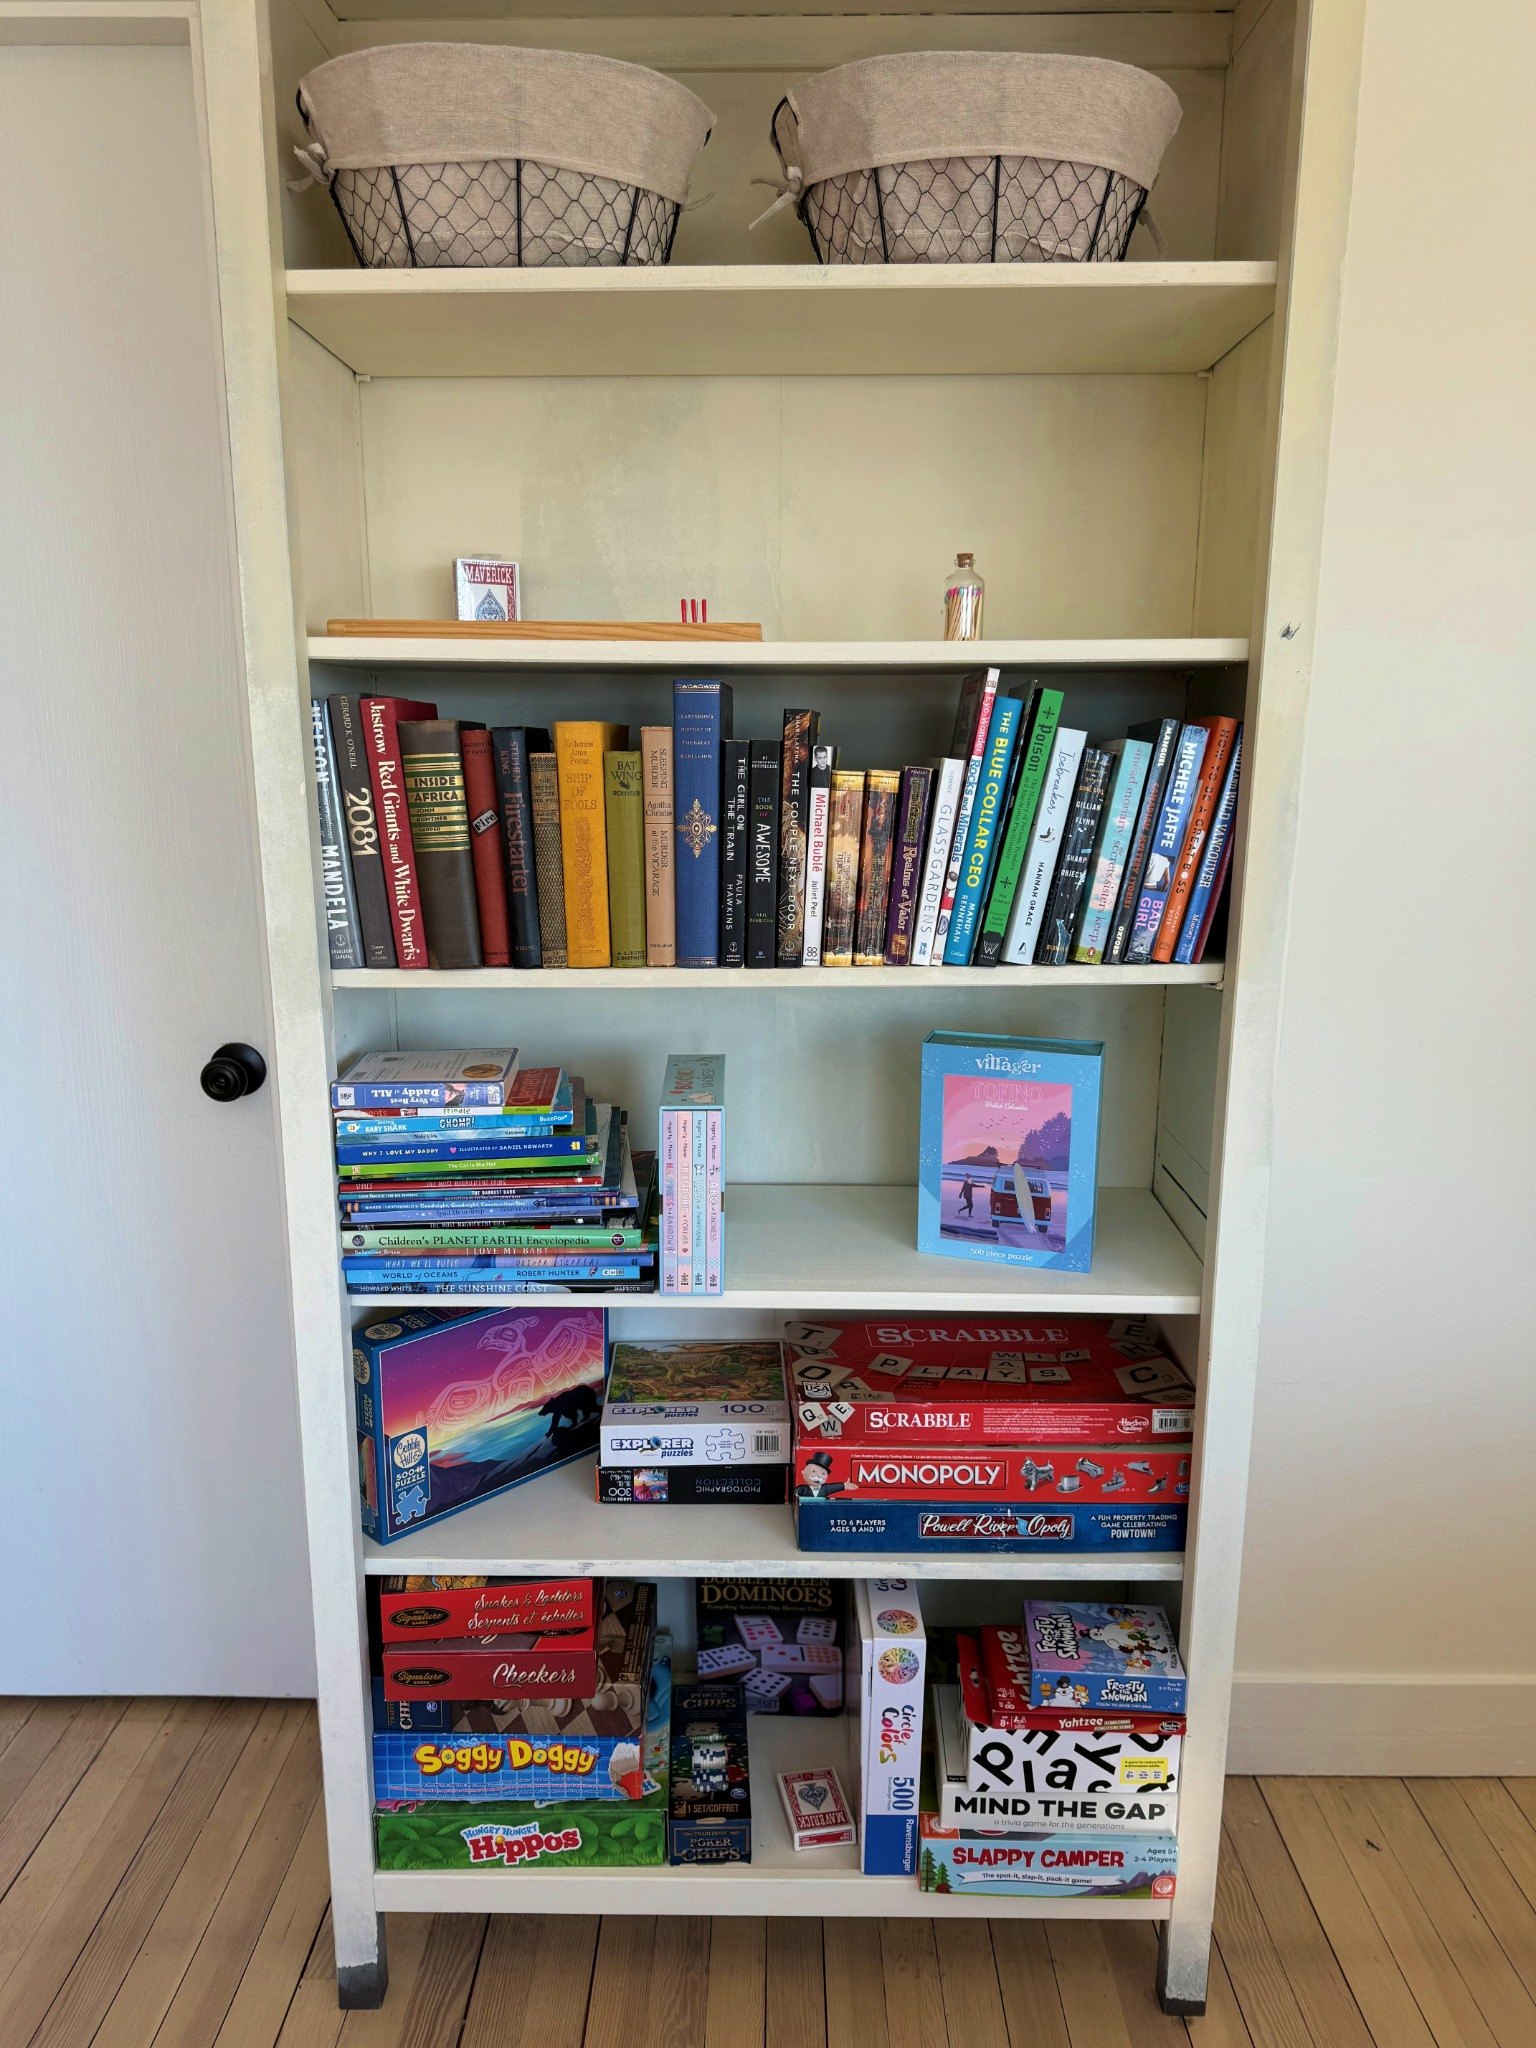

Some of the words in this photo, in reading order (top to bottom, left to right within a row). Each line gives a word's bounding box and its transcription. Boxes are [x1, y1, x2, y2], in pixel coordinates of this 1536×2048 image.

[464, 565, 513, 584] MAVERICK
[370, 702, 387, 755] Jastrow
[1000, 711, 1012, 733] THE
[564, 740, 594, 748] Katherine
[1028, 723, 1053, 772] Poison
[1216, 729, 1229, 760] HOW
[500, 750, 510, 775] KING
[511, 741, 521, 782] STEPHEN
[617, 761, 638, 770] BAT
[651, 750, 659, 788] MURDER
[737, 758, 745, 779] THE
[989, 738, 1009, 779] BLUE
[379, 761, 398, 789] Red
[415, 777, 455, 787] INSIDE
[566, 773, 591, 784] SHIP
[611, 771, 642, 781] WING
[791, 772, 800, 795] THE
[964, 760, 980, 795] Rocks
[1047, 748, 1076, 815] Icebreaker
[1171, 742, 1198, 804] MICHELE
[415, 791, 459, 802] AFRICA
[572, 787, 586, 796] OF
[737, 785, 745, 811] GIRL
[564, 800, 597, 810] FOOLS
[645, 808, 672, 817] Christie
[647, 801, 671, 810] Agatha
[728, 797, 736, 819] THE
[961, 797, 969, 810] and
[1076, 801, 1101, 811] GILLIAN
[345, 787, 378, 856] 2081
[383, 792, 402, 840] Giants
[737, 814, 745, 830] ON
[789, 802, 799, 851] COUPLE
[814, 794, 826, 838] Michael
[974, 782, 999, 849] COLLAR
[1075, 816, 1095, 826] FLYNN
[933, 805, 952, 859] GLASS
[951, 811, 970, 863] Minerals
[1160, 806, 1182, 849] JAFFE
[390, 844, 404, 864] and
[505, 793, 529, 896] Firestarter
[726, 826, 736, 861] TRAIN
[755, 823, 771, 883] AWESOME
[812, 840, 823, 872] Bublé
[903, 846, 917, 887] Realms
[1066, 854, 1088, 863] SHARP
[1199, 824, 1227, 888] VANCOUVER
[651, 852, 660, 896] VICARAGE
[788, 858, 797, 888] NEXT
[966, 853, 984, 888] CEO
[1031, 862, 1044, 898] HANNAH
[322, 845, 349, 930] MANDELA
[394, 864, 411, 907] White
[811, 880, 819, 900] Juliet
[920, 860, 943, 933] GARDENS
[726, 884, 734, 930] HAWKINS
[787, 896, 796, 930] DOOR
[810, 902, 818, 917] Peel
[1025, 900, 1037, 926] GRACE
[1135, 897, 1152, 930] GIRL
[1147, 900, 1163, 932] BAD
[953, 895, 969, 943] RENNEHAN
[964, 902, 976, 935] MANDY
[399, 909, 420, 961] Dwarfs
[1113, 926, 1124, 955] OXFORD
[976, 1053, 1041, 1075] villager
[371, 1089, 393, 1097] ALL
[401, 1088, 440, 1098] Daddy
[971, 1080, 1044, 1104] TOFINO
[439, 1117, 475, 1128] CHOMP!
[378, 1236, 429, 1246] Children's
[433, 1236, 479, 1245] PLANET
[482, 1236, 522, 1245] EARTH
[526, 1235, 590, 1246] Encyclopedia
[385, 1260, 405, 1268] WHAT
[437, 1259, 459, 1268] BUILD
[516, 1259, 548, 1267] OLIVER
[1008, 1252, 1034, 1262] puzzle
[516, 1269, 546, 1277] ROBERT
[434, 1284, 456, 1293] THE
[458, 1284, 512, 1293] SUNSHINE
[515, 1284, 549, 1293] COAST
[876, 1328, 1069, 1343] SCRABBLE
[805, 1384, 830, 1393] USA
[719, 1404, 765, 1413] 100
[869, 1411, 971, 1429] SCRABBLE
[661, 1449, 694, 1458] puzzles
[395, 1471, 426, 1488] PUZZLE
[695, 1478, 761, 1486] COLLECTION
[857, 1464, 1001, 1486] MONOPOLY
[608, 1487, 632, 1496] 300
[695, 1485, 761, 1493] PHOTOGRAPHIC
[922, 1514, 974, 1535] Powell
[1028, 1514, 1071, 1539] Opoly
[1111, 1529, 1156, 1538] POWTOWN!
[474, 1594, 519, 1611] Snakes
[701, 1585, 833, 1607] DOMINOES
[467, 1612, 519, 1631] Serpents
[491, 1663, 578, 1689] Checkers
[1106, 1678, 1145, 1693] FROSTY
[1100, 1689, 1148, 1704] SNOWMAN
[1058, 1718, 1103, 1730] Yahtzee
[880, 1707, 900, 1764] Colors
[415, 1745, 502, 1774] Soggy
[509, 1739, 598, 1775] Doggy
[892, 1777, 915, 1811] 500
[694, 1803, 740, 1812] SET/COFFRET
[954, 1796, 1030, 1816] MIND
[1038, 1800, 1097, 1818] THE
[1104, 1802, 1166, 1821] GAP
[798, 1811, 846, 1828] MAVERICK
[1024, 1820, 1048, 1829] game
[1061, 1820, 1075, 1828] the
[1076, 1822, 1125, 1831] generations
[469, 1829, 581, 1863] Hippos
[689, 1838, 732, 1846] POKER
[903, 1819, 914, 1872] Ravensburger
[1146, 1848, 1166, 1856] Ages
[681, 1848, 741, 1862] CHIPS
[952, 1847, 1036, 1867] SLAPPY
[1041, 1849, 1125, 1868] CAMPER
[1149, 1856, 1177, 1864] Players
